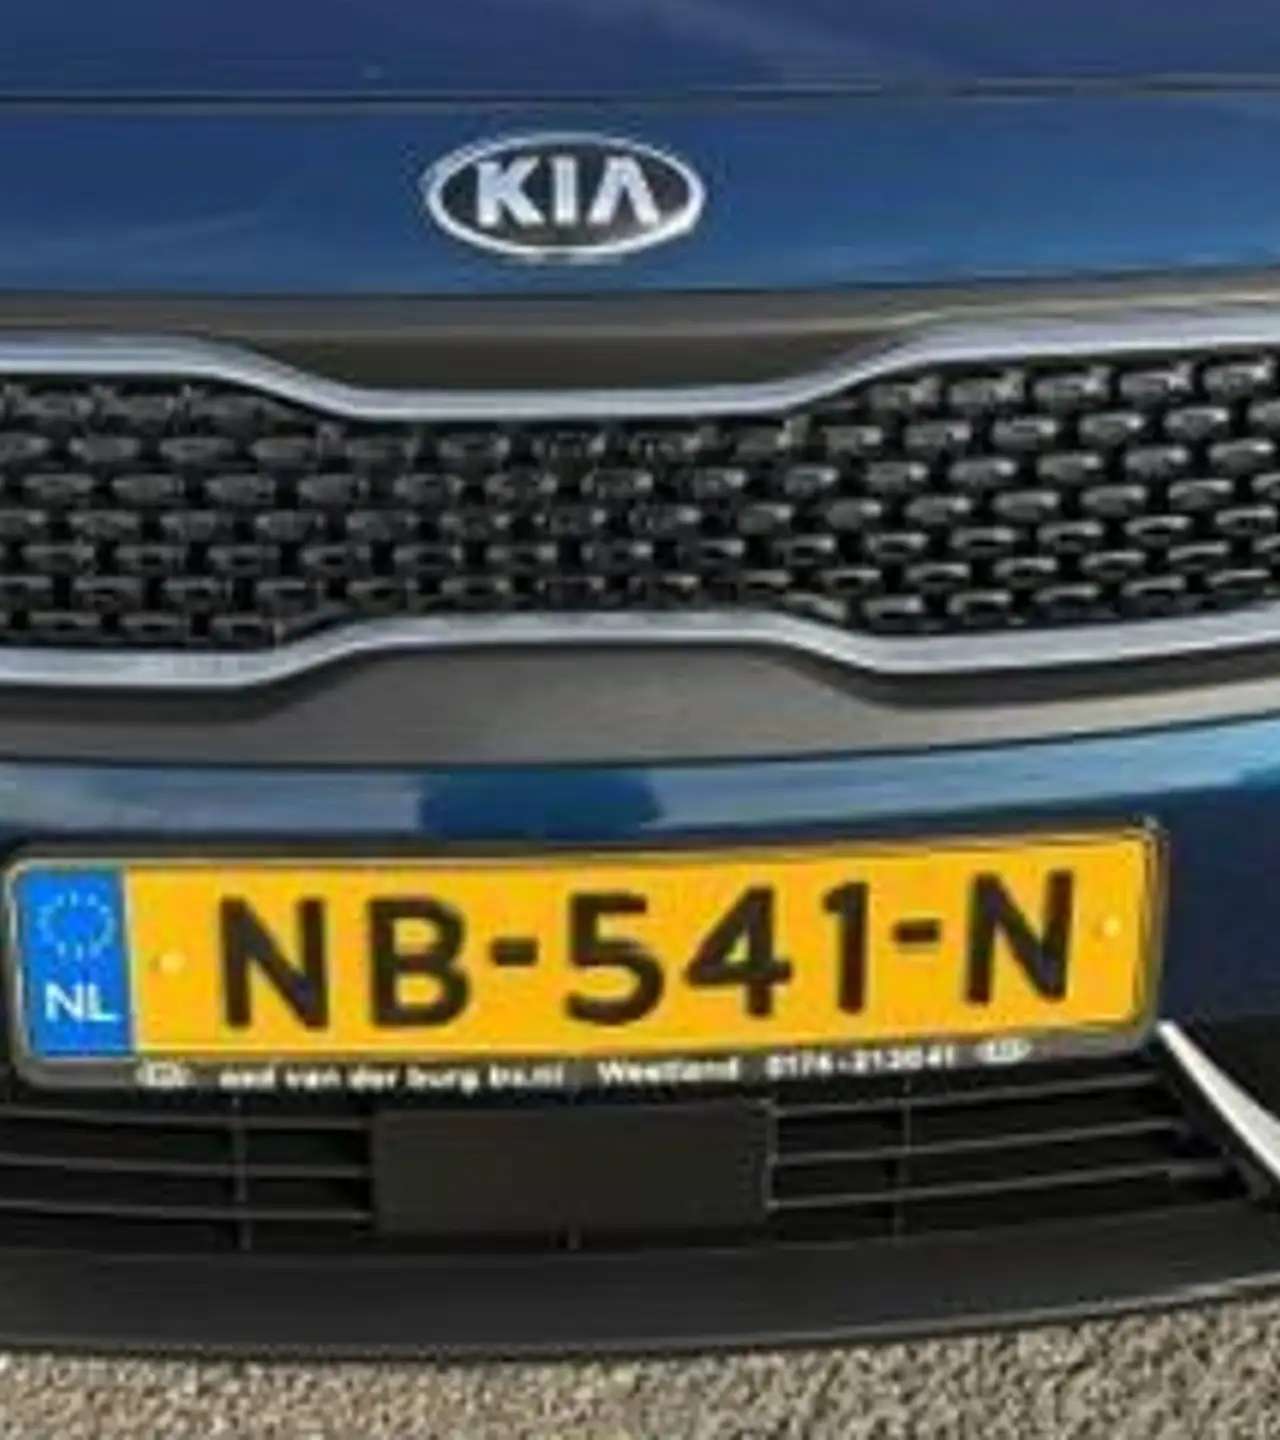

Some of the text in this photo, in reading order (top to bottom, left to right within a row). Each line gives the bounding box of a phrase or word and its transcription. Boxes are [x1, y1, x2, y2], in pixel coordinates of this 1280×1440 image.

[475, 156, 660, 227] KIA
[218, 868, 1075, 1031] NB-541-N
[44, 983, 118, 1022] NL
[348, 1062, 398, 1091] der
[595, 1056, 740, 1085] Westland
